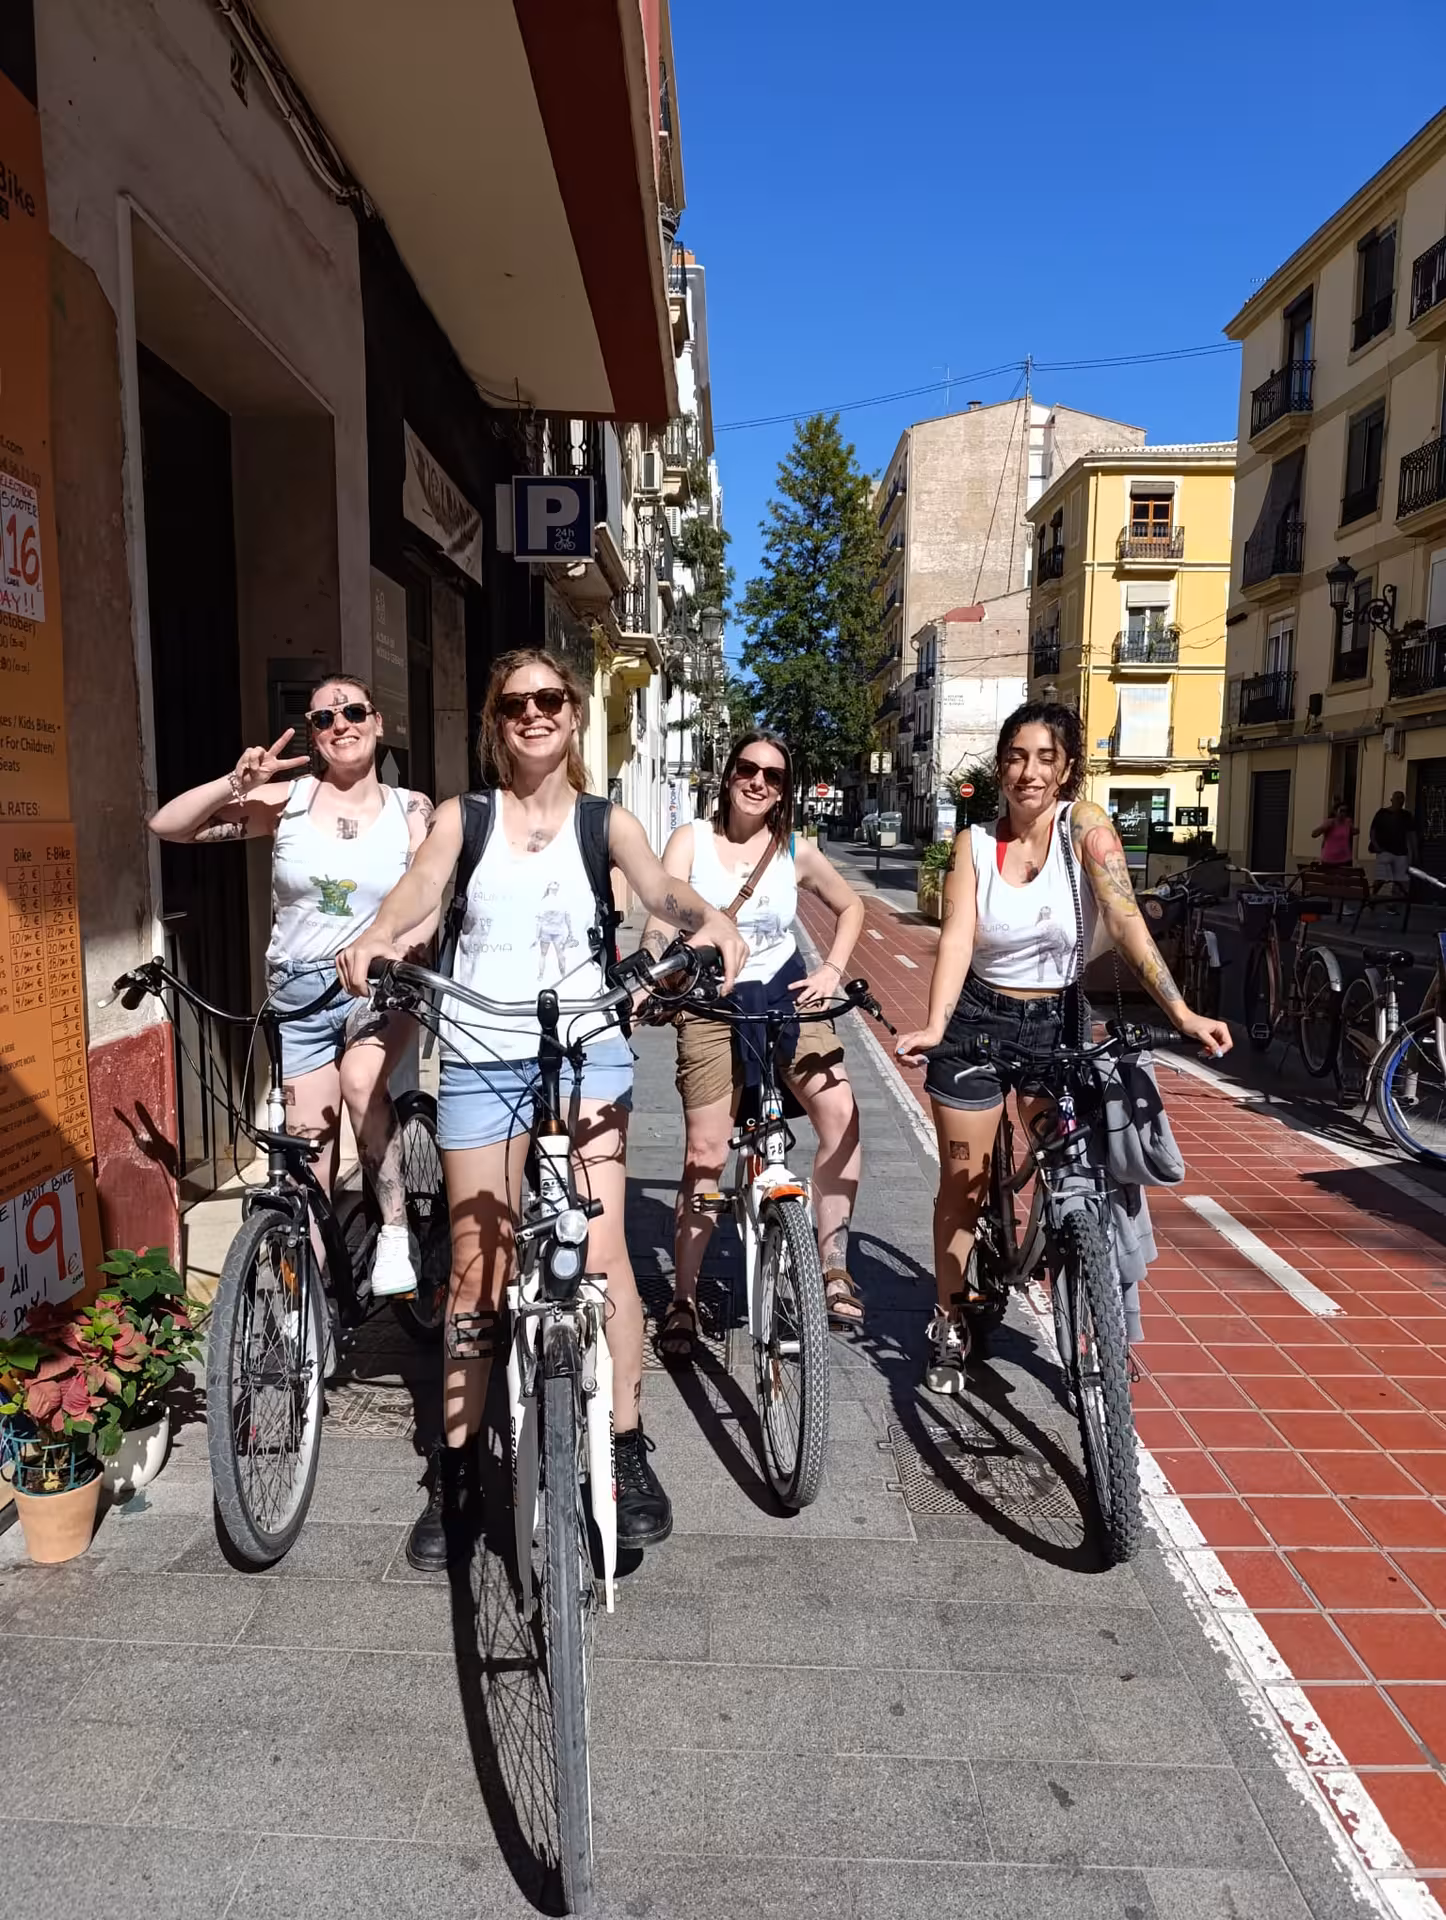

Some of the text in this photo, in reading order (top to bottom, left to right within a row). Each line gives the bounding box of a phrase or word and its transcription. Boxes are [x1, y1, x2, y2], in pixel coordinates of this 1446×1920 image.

[1, 491, 38, 518] SCOOTER
[527, 485, 579, 550] P
[555, 528, 575, 537] 24h
[7, 514, 40, 586] 16
[19, 716, 36, 730] Kids
[37, 718, 57, 733] Bikes
[6, 736, 20, 750] For
[8, 801, 41, 816] RATES:
[14, 846, 71, 862] Bike E-Bike
[51, 1170, 75, 1192] BIKE
[25, 1191, 68, 1281] 9
[10, 1264, 29, 1299] All
